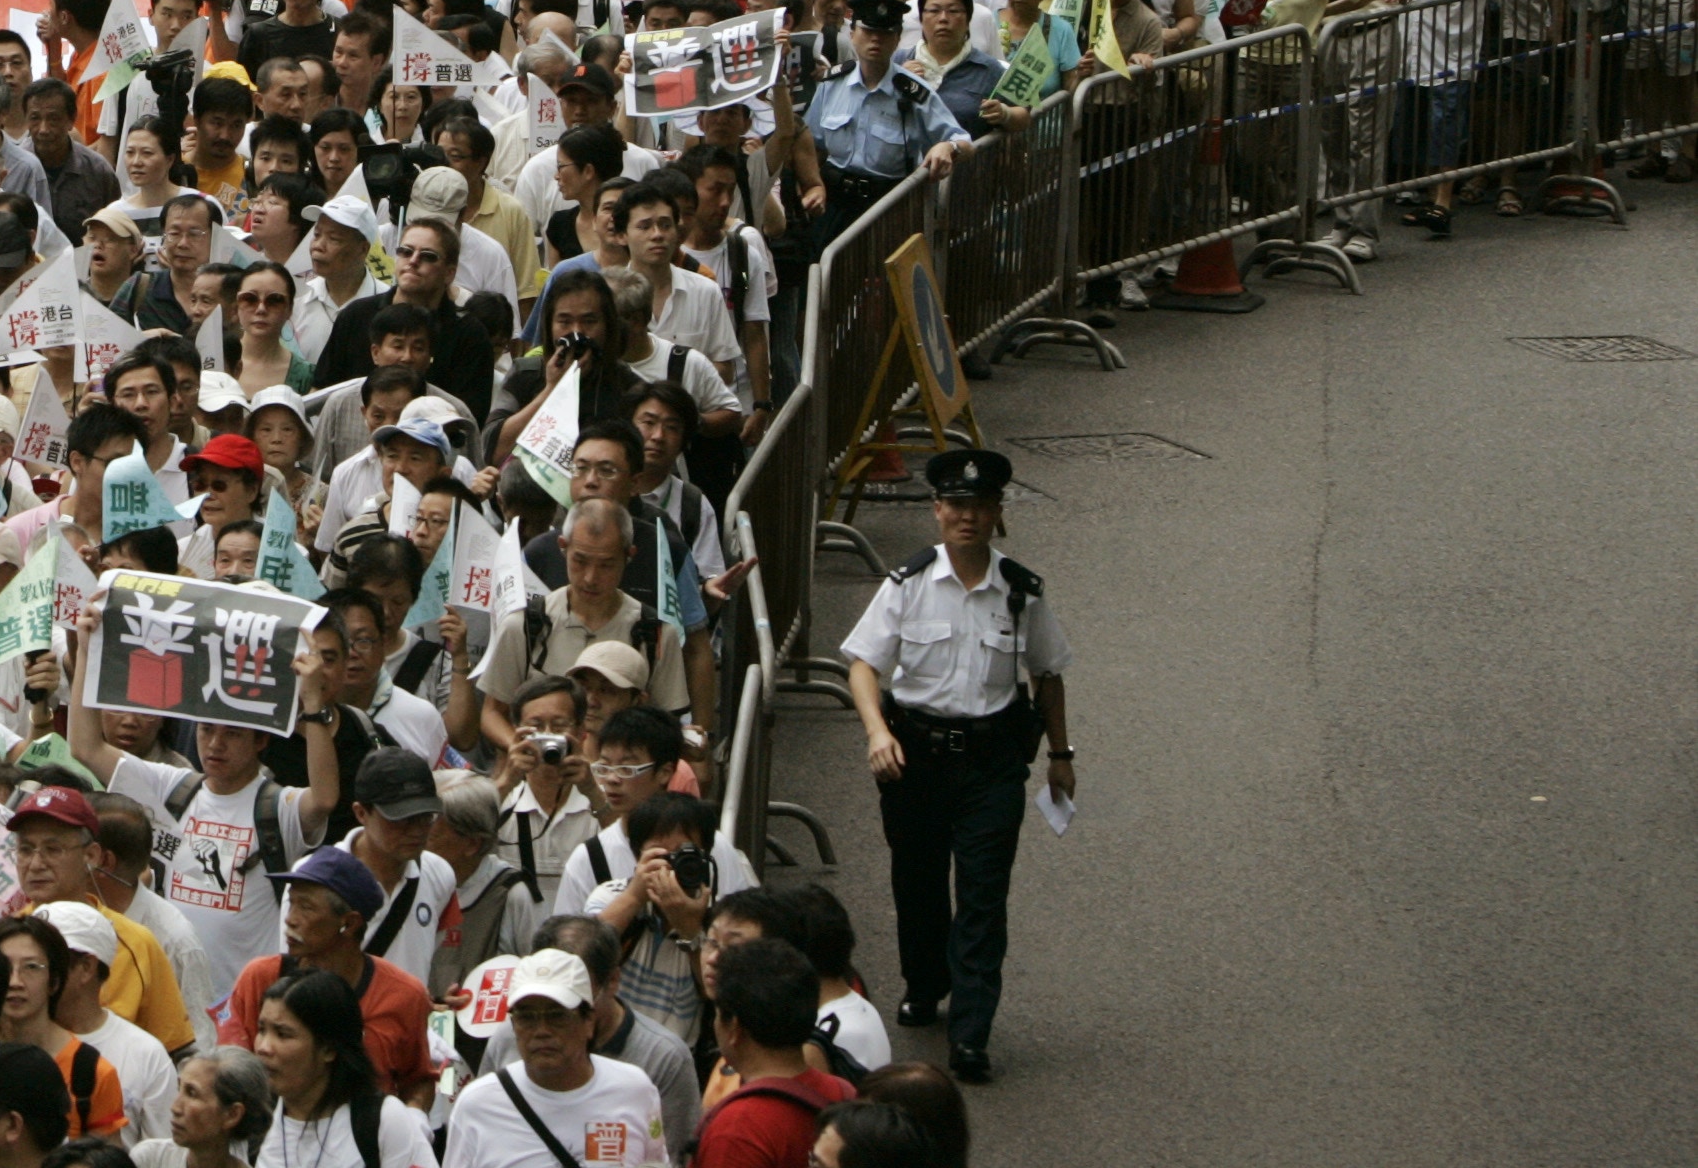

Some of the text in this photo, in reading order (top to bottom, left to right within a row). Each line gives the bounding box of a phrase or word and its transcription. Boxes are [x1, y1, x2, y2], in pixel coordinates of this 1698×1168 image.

[116, 22, 137, 40] 港台
[403, 52, 473, 83] 撐 普選
[8, 304, 73, 350] 撐 港台
[19, 576, 54, 603] 教協
